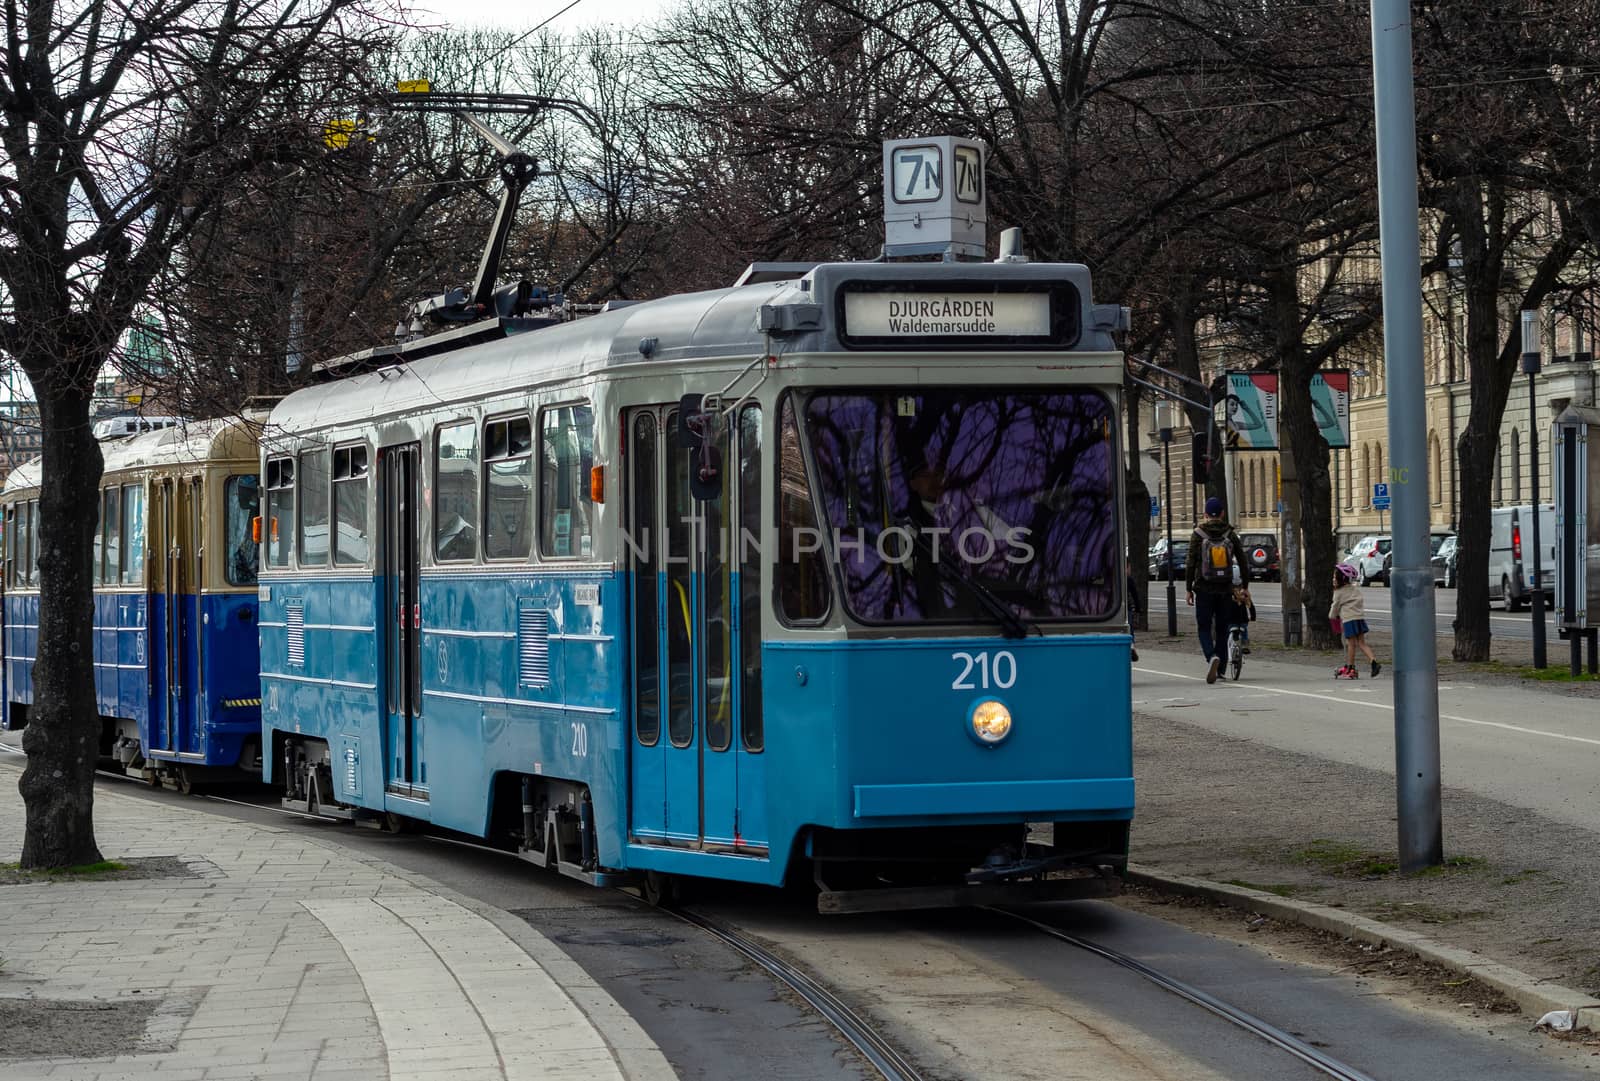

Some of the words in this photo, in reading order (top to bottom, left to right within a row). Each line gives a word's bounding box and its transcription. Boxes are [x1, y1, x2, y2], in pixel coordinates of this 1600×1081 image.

[900, 155, 940, 196] 7N
[956, 155, 977, 194] 7N
[889, 297, 994, 317] DJURGÅRDEN
[888, 319, 996, 333] Waldemarsudde
[1378, 484, 1385, 496] P
[951, 651, 1018, 690] 210
[571, 722, 588, 758] 210
